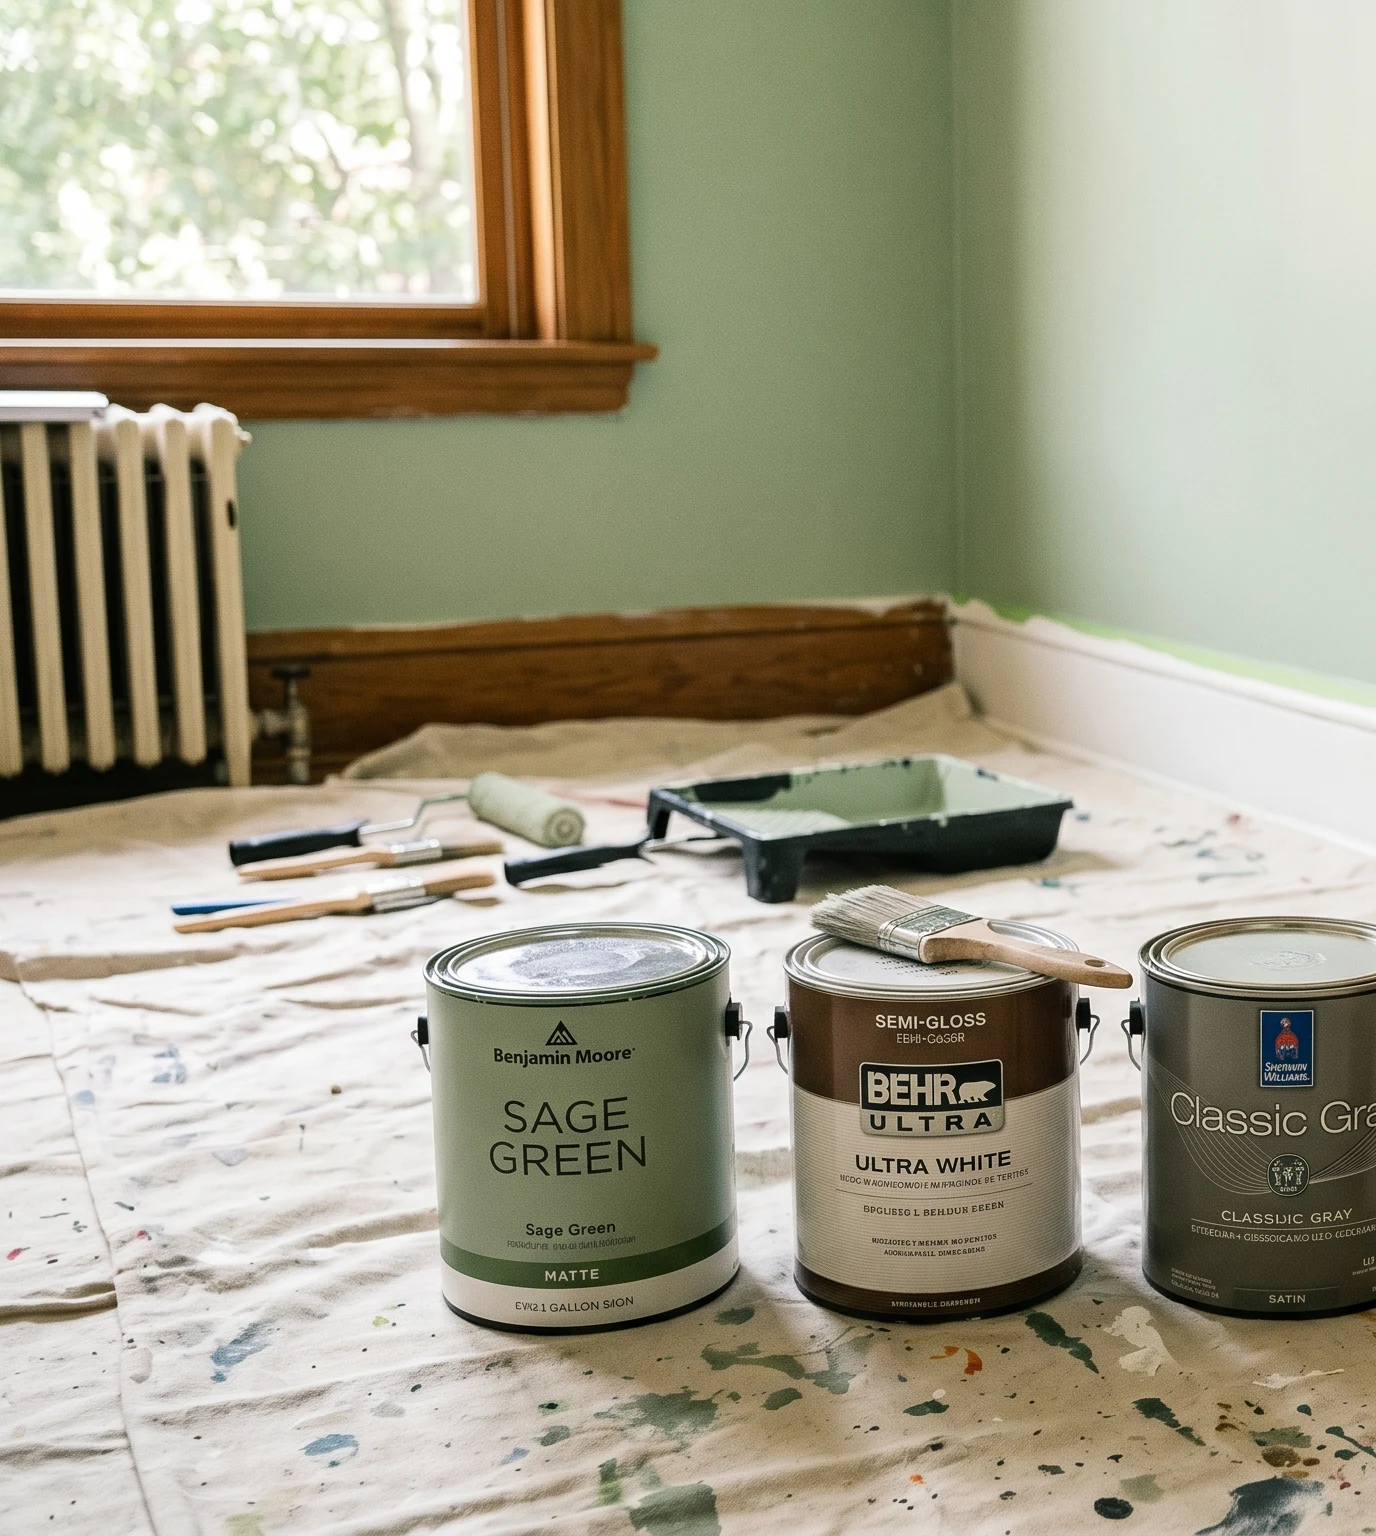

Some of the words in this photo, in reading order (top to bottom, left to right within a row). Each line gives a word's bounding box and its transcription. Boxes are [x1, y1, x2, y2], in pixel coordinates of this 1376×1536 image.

[876, 1012, 986, 1029] SEMI-GLOSS
[494, 1048, 571, 1068] Benjamin
[575, 1047, 632, 1064] Moore
[867, 1071, 958, 1106] BEHR
[503, 1096, 629, 1134] SAGE
[870, 1112, 992, 1132] ULTRA
[1170, 1091, 1307, 1137] Classic
[489, 1136, 647, 1176] GREEN
[855, 1154, 929, 1175] ULTRA
[936, 1149, 1012, 1173] WHITE
[1310, 1208, 1353, 1224] GRAY
[526, 1223, 563, 1239] Sage
[568, 1221, 616, 1236] Green
[544, 1269, 600, 1282] MATTE
[549, 1301, 600, 1312] GALLON
[1268, 1294, 1306, 1304] SATIN
